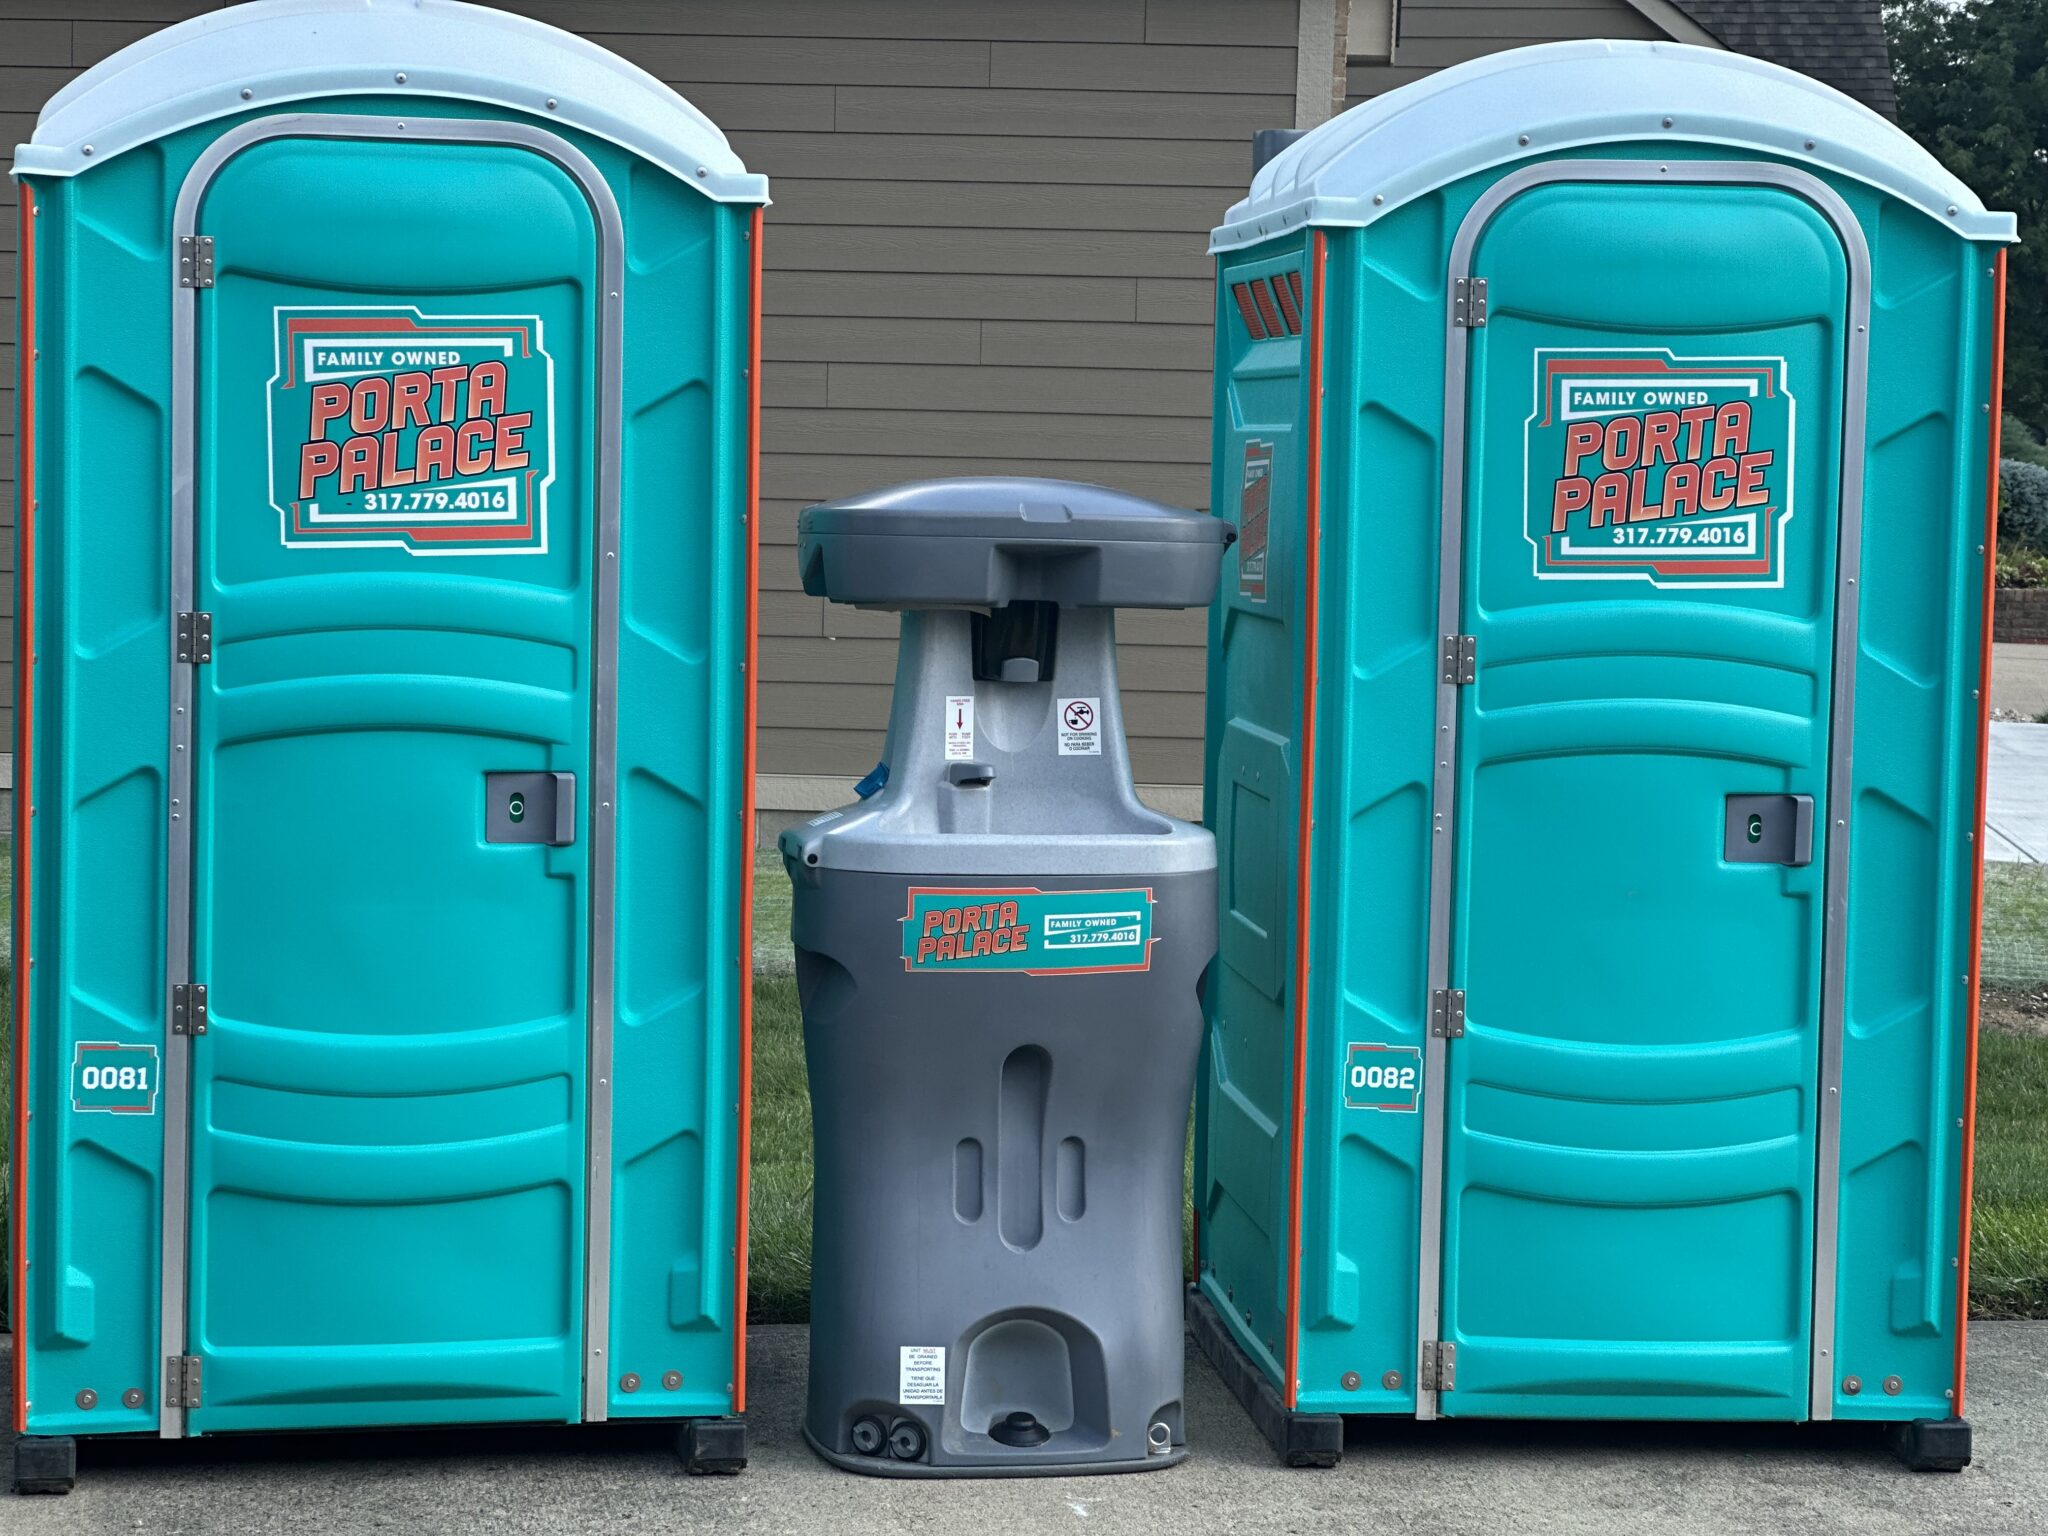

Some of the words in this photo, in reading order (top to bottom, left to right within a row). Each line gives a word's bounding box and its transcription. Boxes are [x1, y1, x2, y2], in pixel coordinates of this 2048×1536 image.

[317, 351, 384, 366] FAMILY
[391, 351, 461, 366] OWNED
[309, 360, 508, 442] PORTA
[1573, 391, 1637, 406] FAMILY
[1643, 391, 1709, 406] OWNED
[1563, 400, 1753, 478] PORTA
[298, 411, 533, 500] PALACE
[364, 492, 506, 511] 317.779.4016
[1550, 449, 1774, 533] PALACE
[1612, 527, 1746, 544] 317.779.4016
[923, 900, 1019, 938] PORTA
[1050, 919, 1082, 929] FAMILY
[1085, 918, 1117, 928] OWNED
[916, 924, 1030, 964] PALACE
[1069, 931, 1135, 944] 317.779.4016
[82, 1066, 148, 1090] 0081
[1351, 1065, 1415, 1090] 0082
